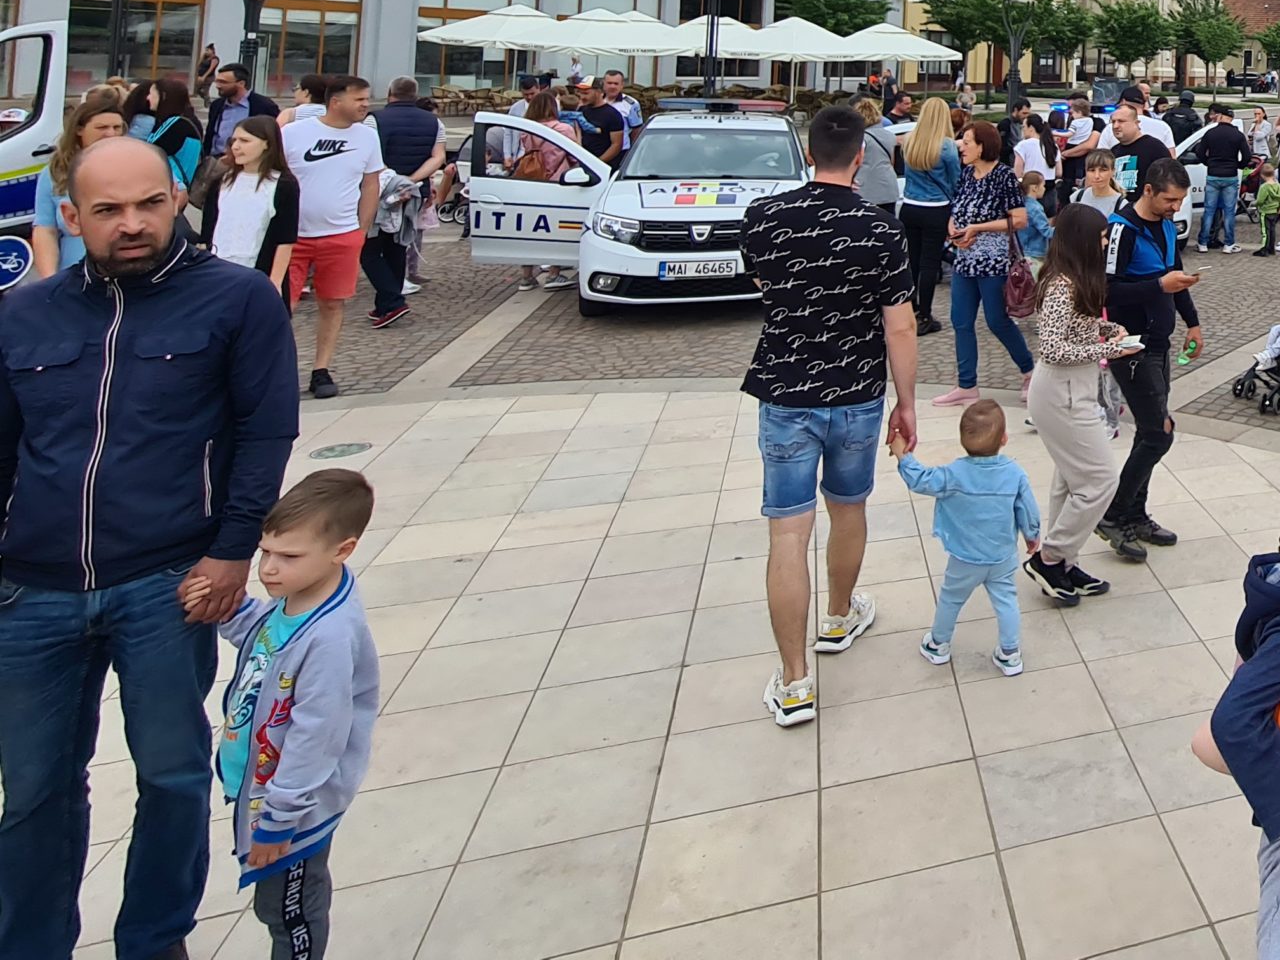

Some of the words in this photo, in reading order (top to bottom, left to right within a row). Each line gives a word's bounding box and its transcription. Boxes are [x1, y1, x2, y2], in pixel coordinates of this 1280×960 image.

[312, 139, 348, 152] NIKE
[474, 210, 551, 233] ITIA
[667, 264, 687, 275] MAI
[695, 262, 733, 274] 46465
